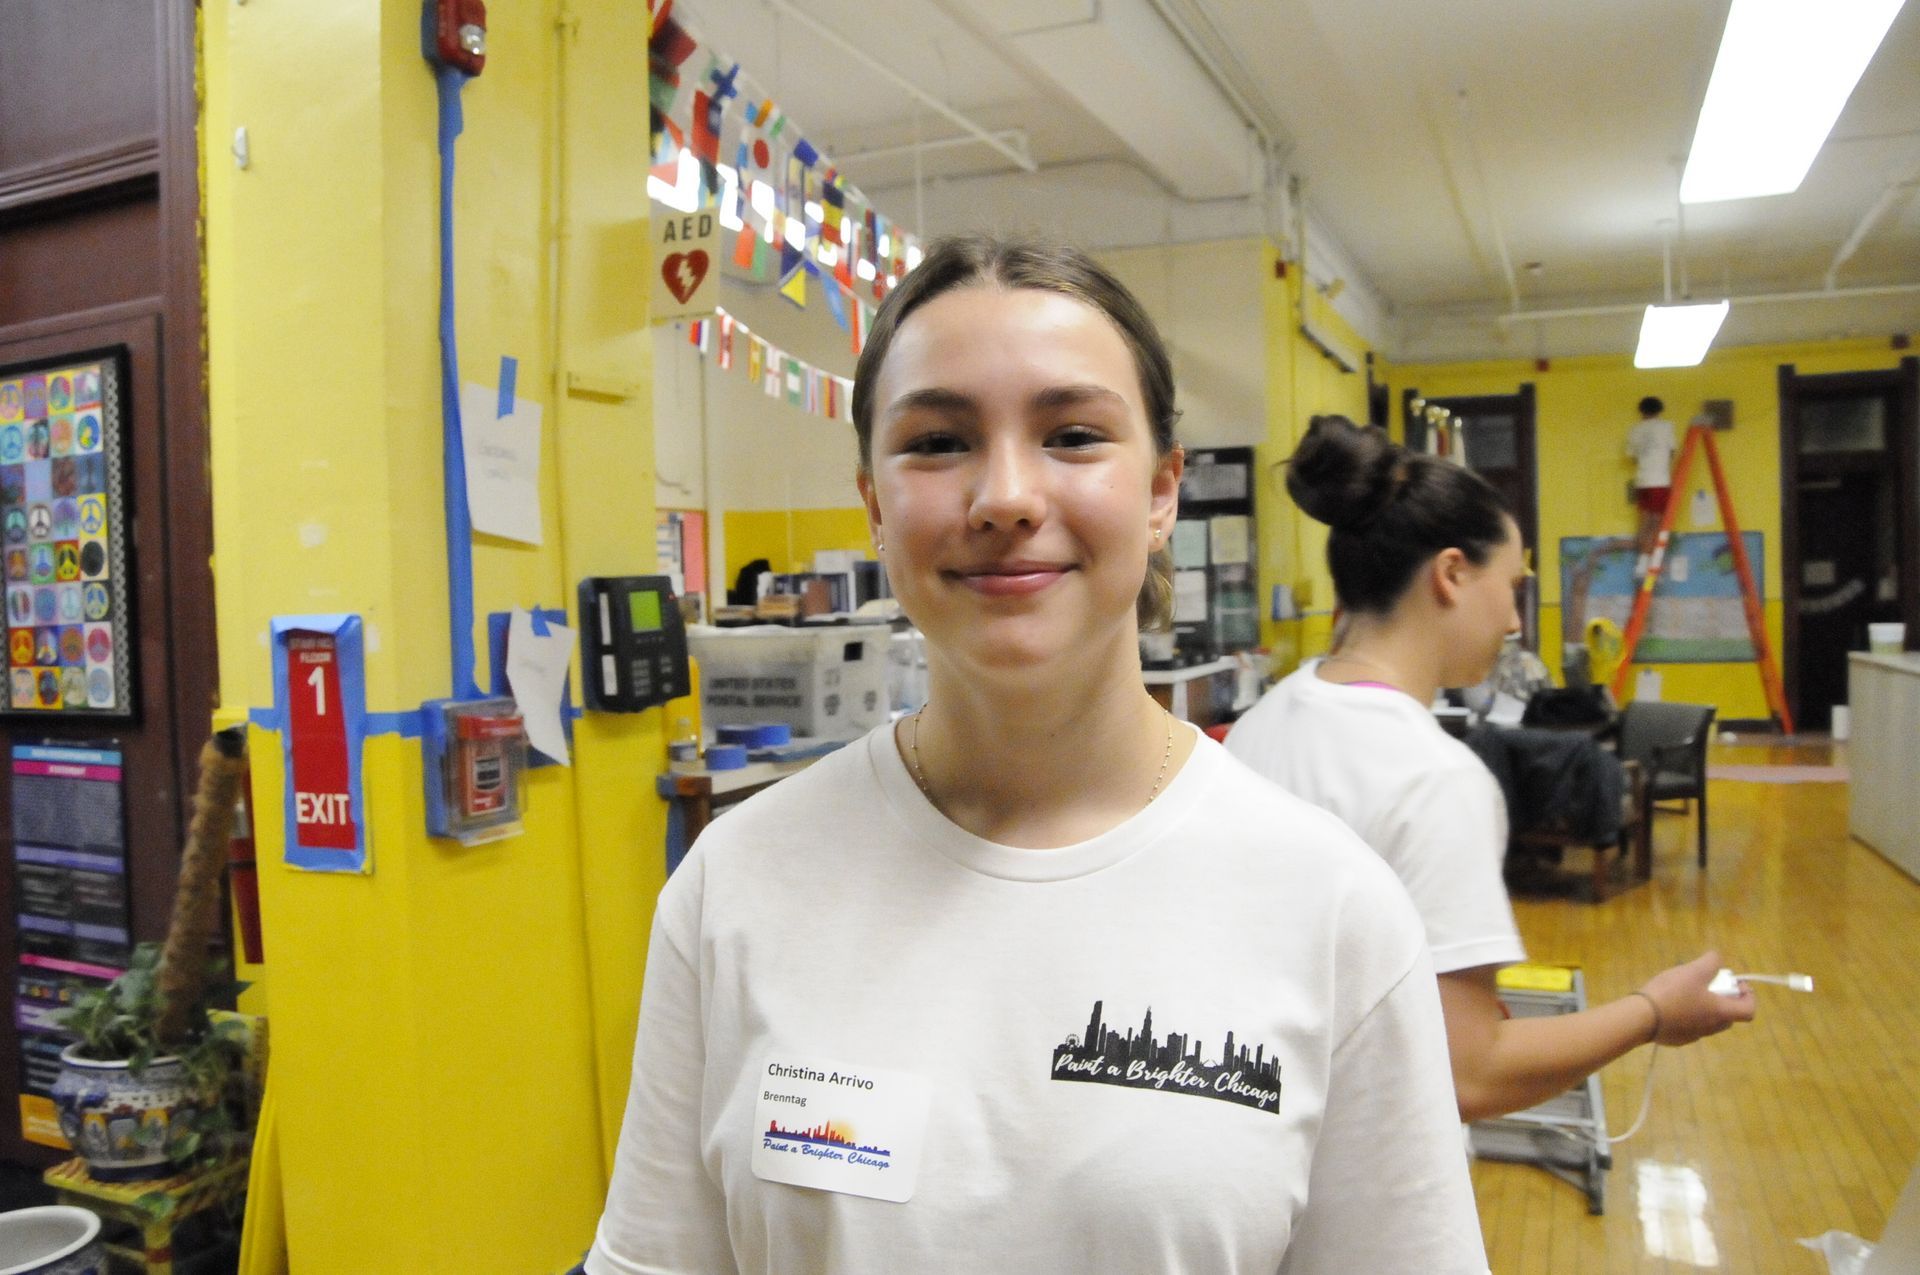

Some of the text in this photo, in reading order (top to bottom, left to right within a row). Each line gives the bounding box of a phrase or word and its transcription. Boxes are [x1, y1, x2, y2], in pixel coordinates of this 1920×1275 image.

[663, 214, 712, 243] AED
[308, 665, 326, 716] 1
[295, 791, 350, 826] EXIT
[768, 1063, 874, 1091] Christina Arrivo
[1055, 1054, 1279, 1107] Paint a Brighter Chicago
[763, 1091, 807, 1107] Brenntag
[763, 1138, 890, 1170] Paint a Brighter Chicago
